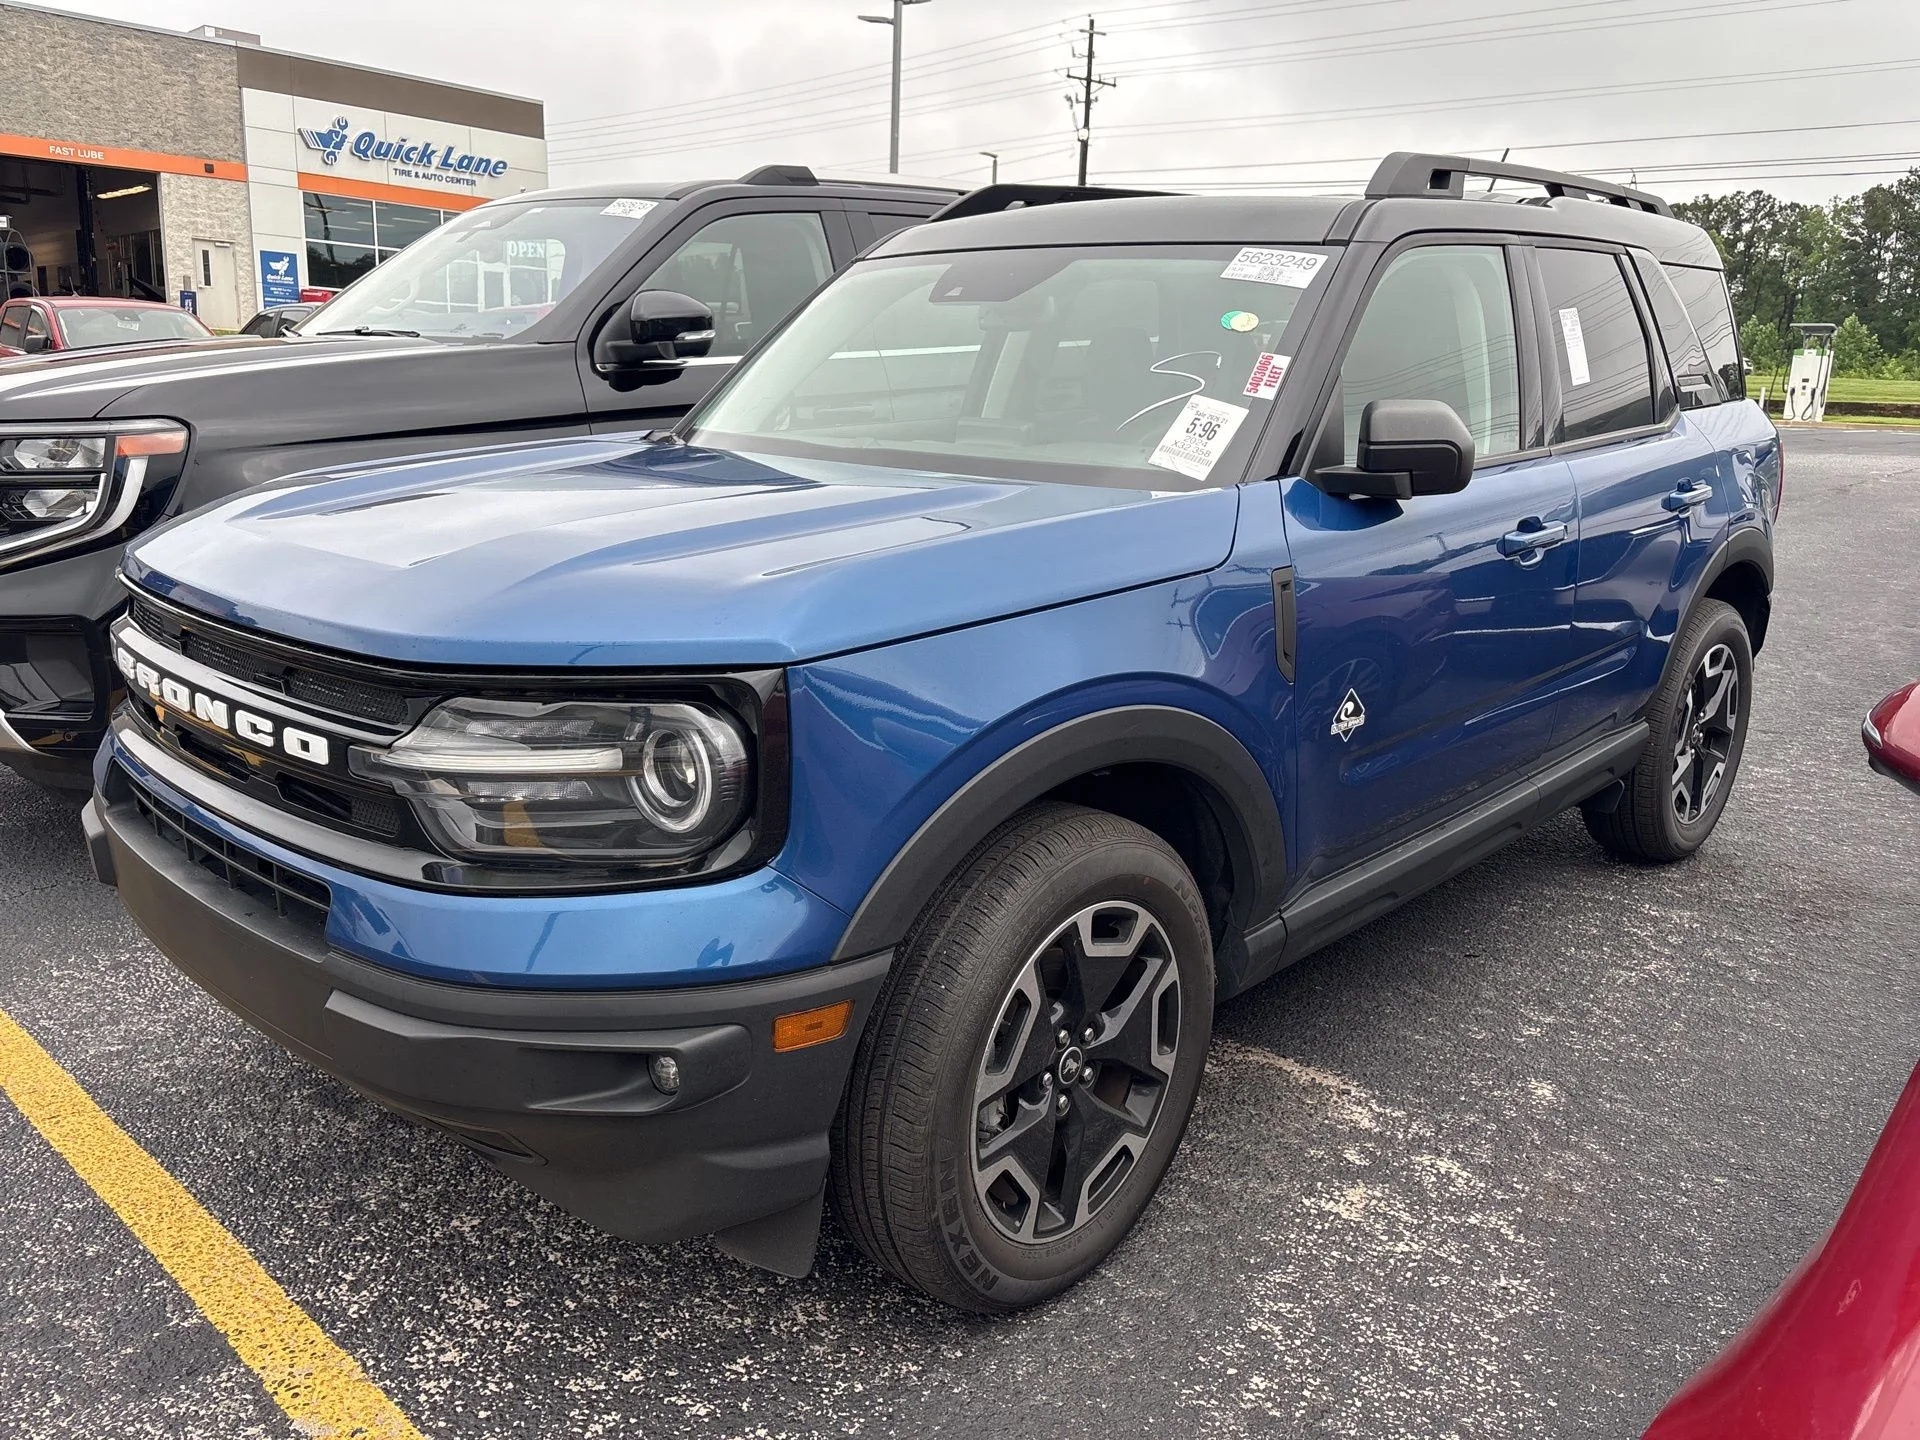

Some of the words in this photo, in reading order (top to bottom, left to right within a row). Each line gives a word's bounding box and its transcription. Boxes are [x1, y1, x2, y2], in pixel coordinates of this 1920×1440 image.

[49, 145, 75, 157] FAST
[78, 149, 105, 160] LUBE
[353, 132, 437, 166] Quick
[439, 146, 508, 177] Lane
[393, 168, 412, 178] TIRE
[414, 171, 420, 179] &
[422, 172, 443, 182] AUTO
[445, 175, 476, 187] CENTER
[507, 240, 545, 258] OPEN
[1238, 251, 1318, 270] 5623249
[1246, 354, 1274, 393] 5403066
[1264, 365, 1284, 388] FLEET
[1186, 417, 1221, 441] 5:96
[1183, 435, 1208, 448] 2024
[117, 647, 329, 765] BRONCO
[938, 1156, 1000, 1291] NEXEN
